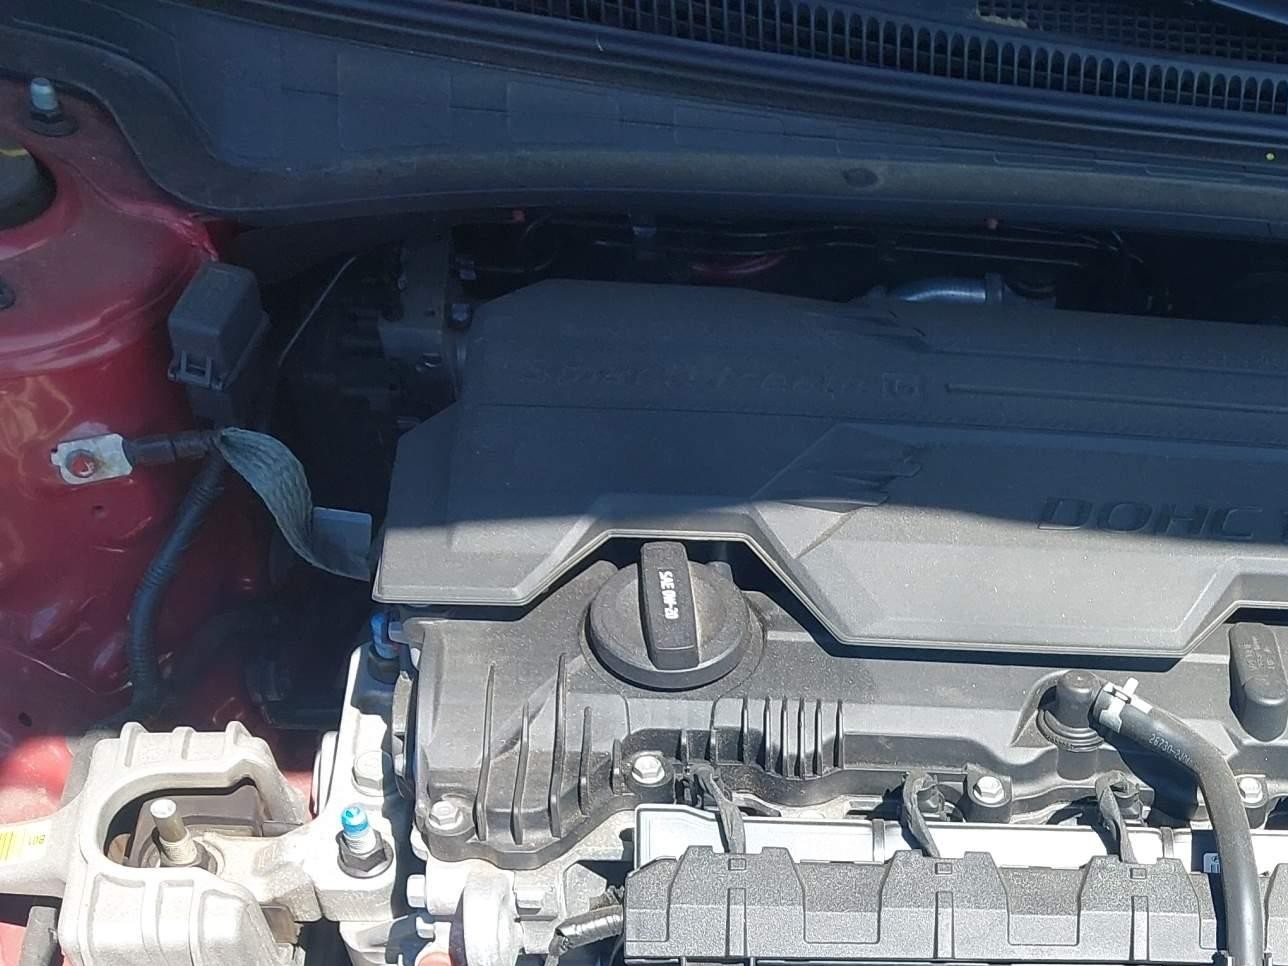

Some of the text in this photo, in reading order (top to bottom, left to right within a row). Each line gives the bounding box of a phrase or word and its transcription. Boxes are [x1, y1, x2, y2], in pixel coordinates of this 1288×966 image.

[1037, 497, 1263, 540] DOHC
[658, 571, 680, 620] SAE 0W-20
